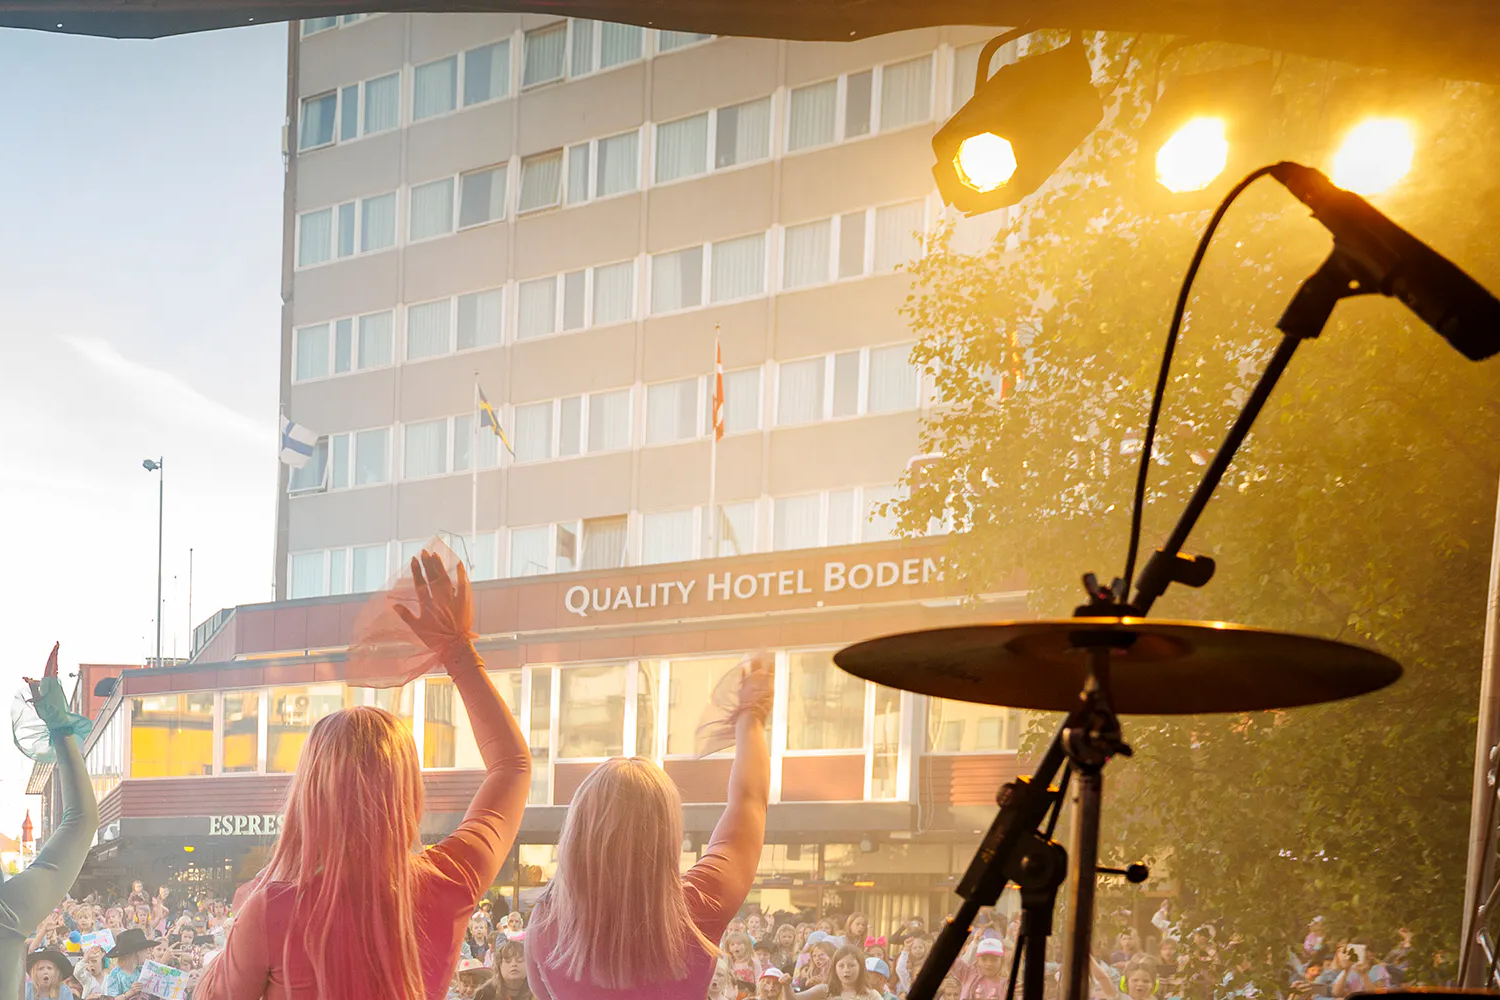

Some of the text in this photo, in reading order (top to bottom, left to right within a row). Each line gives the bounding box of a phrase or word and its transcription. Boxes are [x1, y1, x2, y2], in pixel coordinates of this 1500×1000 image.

[564, 556, 947, 618] QUALITY HOTEL BODEN
